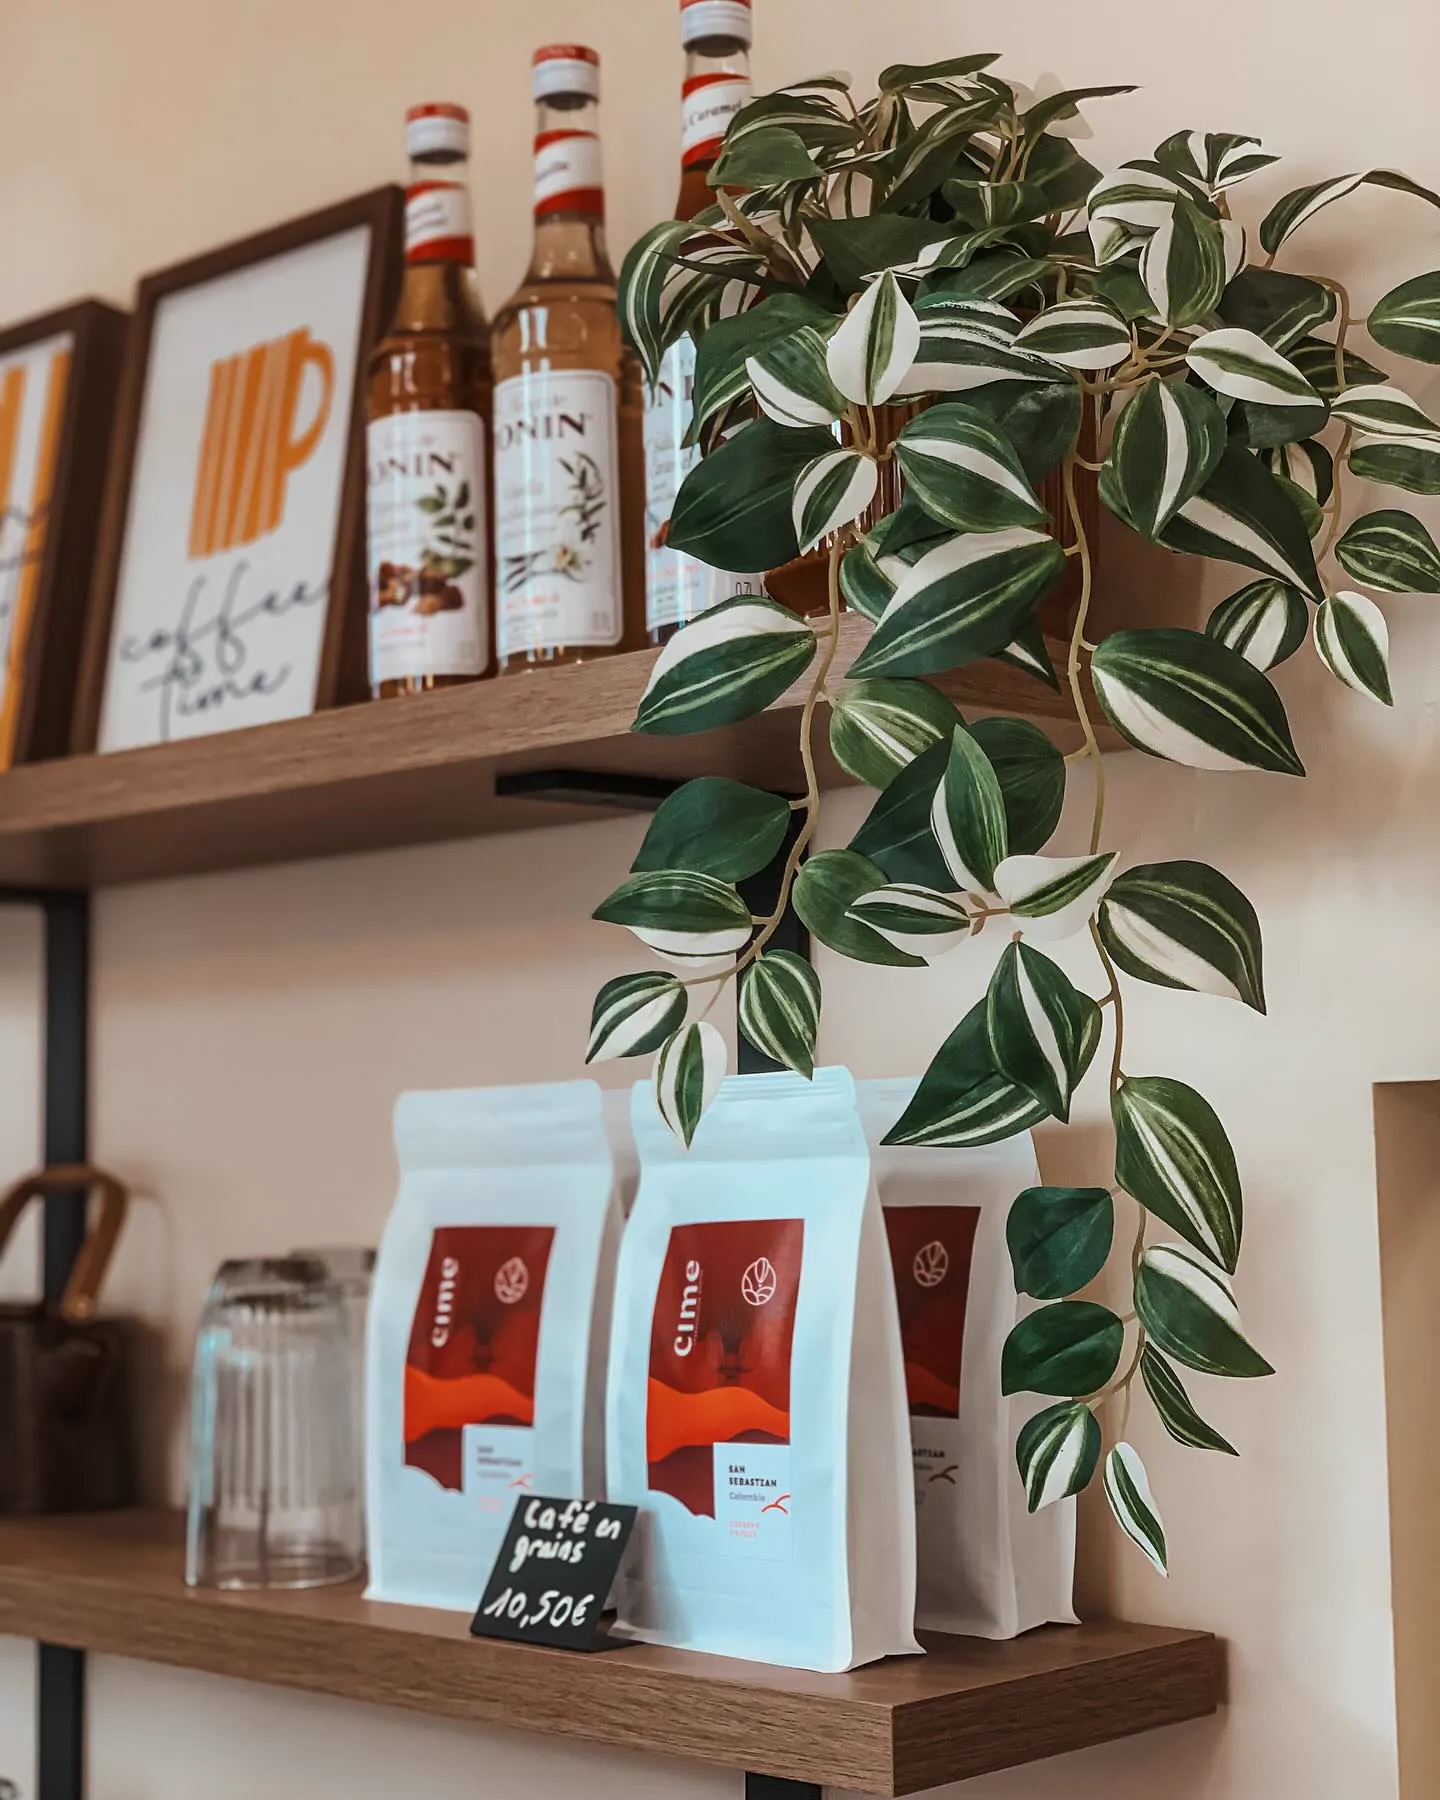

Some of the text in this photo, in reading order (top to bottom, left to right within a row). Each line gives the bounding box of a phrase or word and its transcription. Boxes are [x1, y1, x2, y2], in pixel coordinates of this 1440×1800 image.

[120, 560, 330, 688] coffee
[673, 1260, 700, 1357] cime
[728, 1465, 746, 1474] SAN
[728, 1477, 778, 1488] SEBASTIAN
[524, 1499, 597, 1534] Café
[594, 1517, 622, 1541] en
[508, 1531, 587, 1573] grains
[483, 1587, 596, 1629] 10,50€
